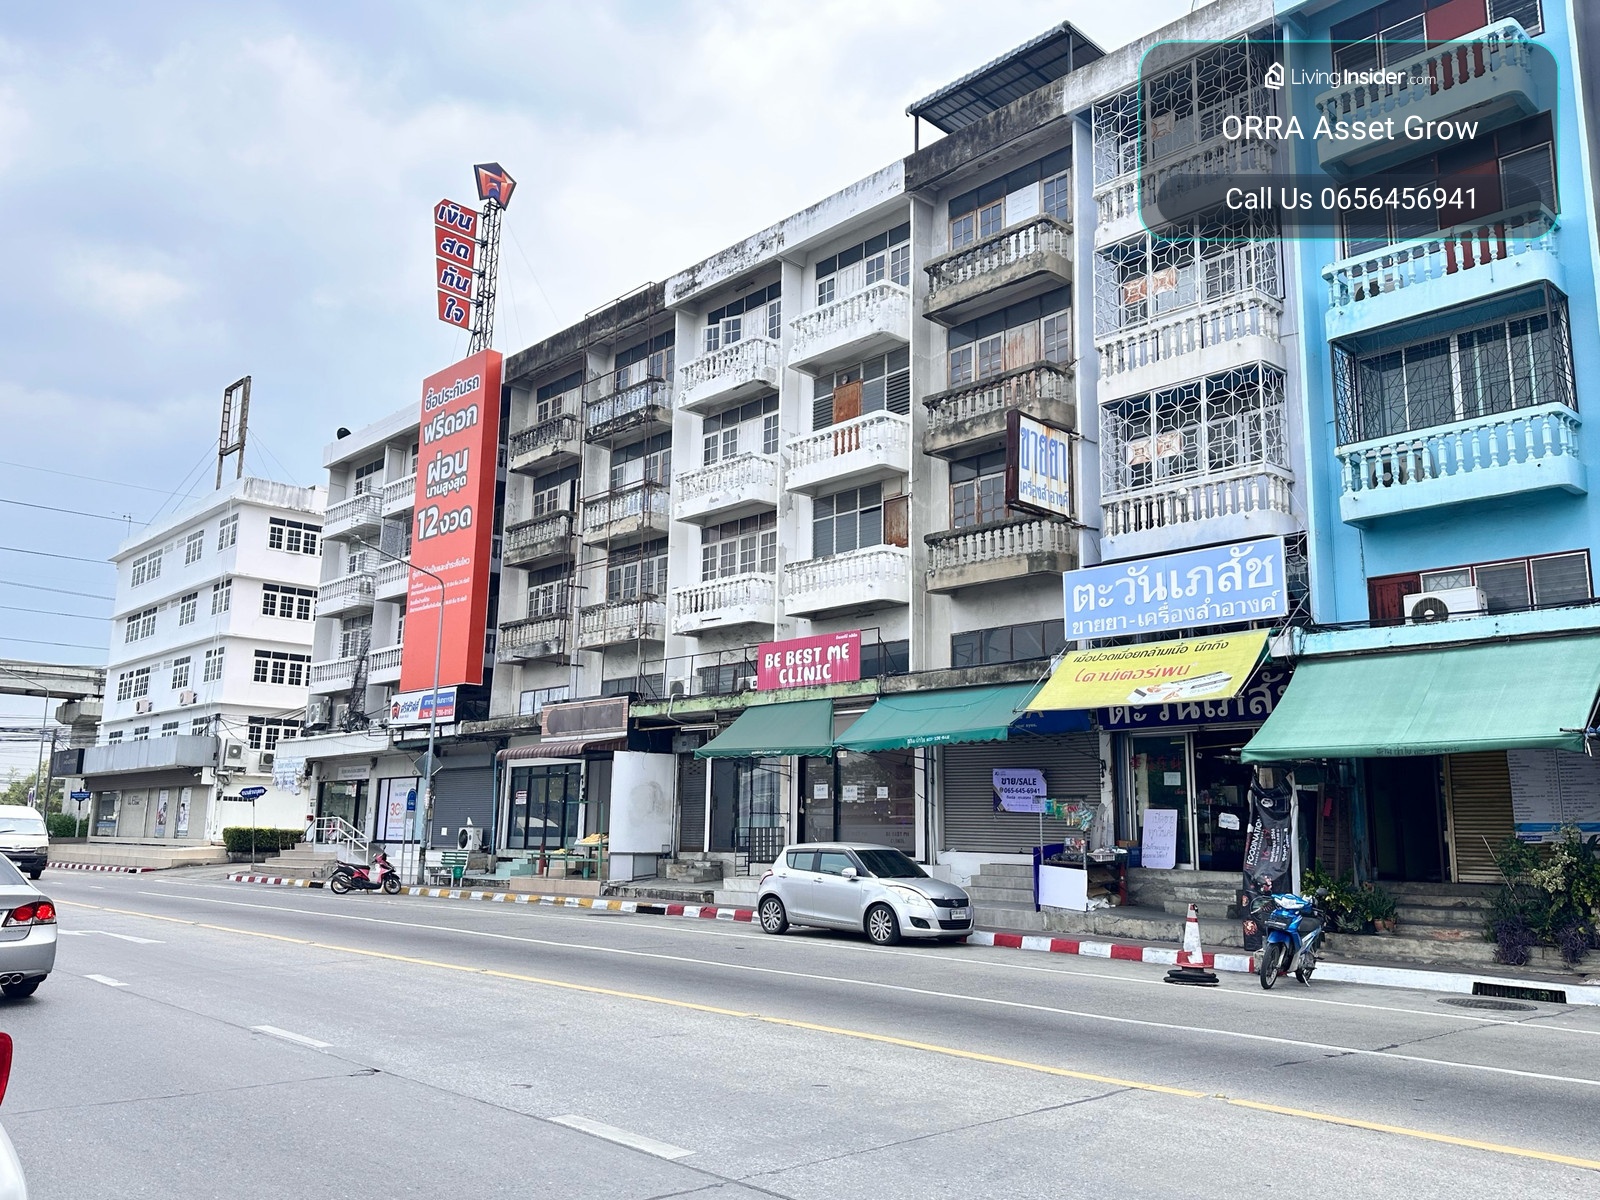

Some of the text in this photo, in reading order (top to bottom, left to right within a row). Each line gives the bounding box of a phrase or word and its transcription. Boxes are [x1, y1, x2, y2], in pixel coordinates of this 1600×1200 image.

[437, 203, 473, 232] เงิน
[440, 237, 471, 261] สด
[440, 266, 471, 293] ทัน
[444, 297, 465, 322] ใจ
[424, 373, 481, 413] ซื้อประกันรถ
[423, 403, 479, 446] ฟรีดอก
[426, 446, 470, 487] ผ่อน
[1020, 426, 1067, 484] ขายยา
[425, 472, 467, 498] นานสูงสุด
[1072, 544, 1275, 614] ตะวันเภสัช
[764, 642, 850, 669] BE BEST ME
[1073, 639, 1229, 664] เมื่อปวดเมื่อยกล้ามเนื้อ นึกถึง
[779, 663, 832, 684] CLINIC
[1001, 777, 1037, 786] ขาย/SALE
[1003, 787, 1040, 795] 065-645-6941
